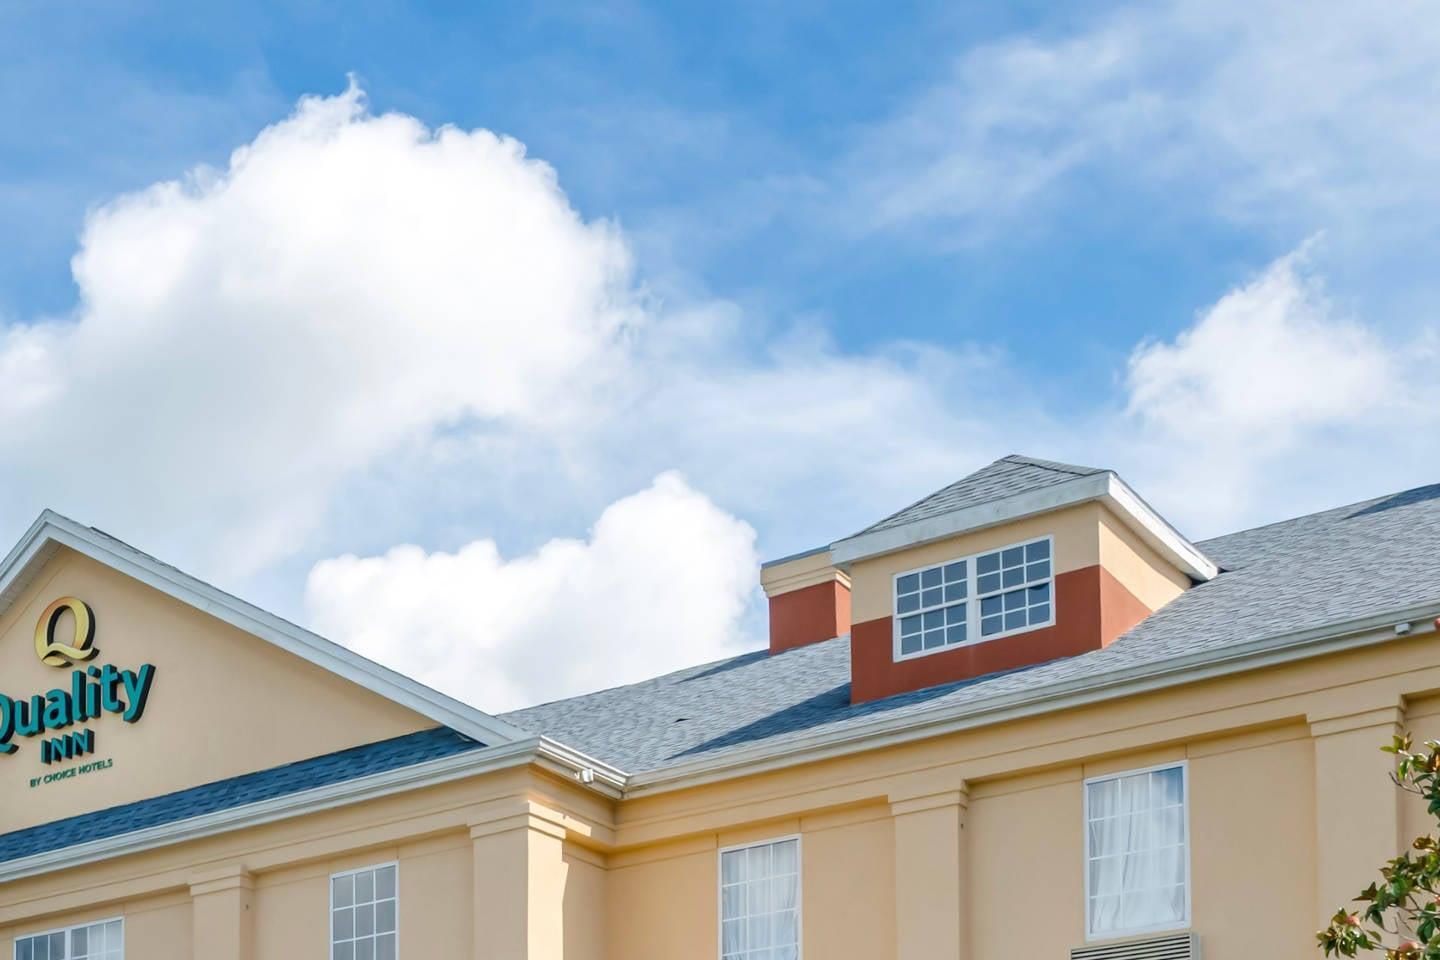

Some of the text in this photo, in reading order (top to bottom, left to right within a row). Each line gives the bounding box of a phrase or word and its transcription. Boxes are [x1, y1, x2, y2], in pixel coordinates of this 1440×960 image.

[34, 596, 100, 667] Q
[41, 729, 95, 765] INN
[30, 758, 113, 788] BY CHOICE HOTELS
